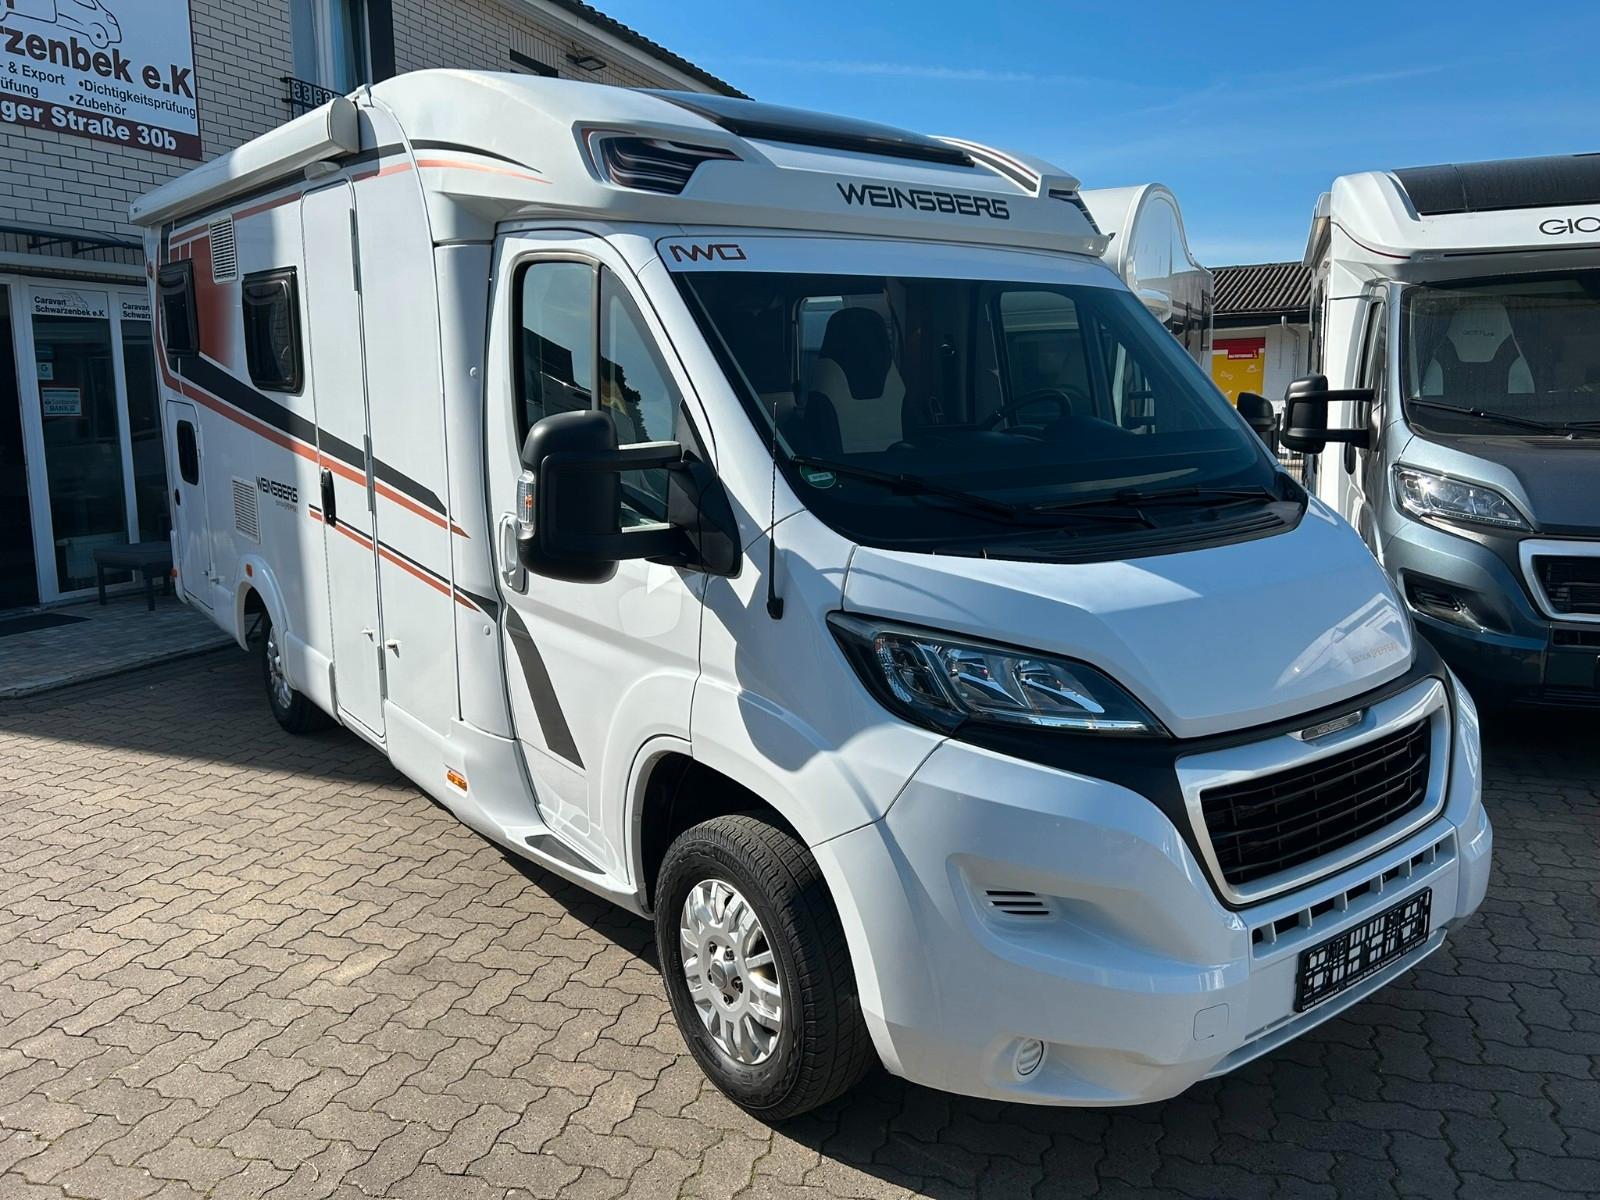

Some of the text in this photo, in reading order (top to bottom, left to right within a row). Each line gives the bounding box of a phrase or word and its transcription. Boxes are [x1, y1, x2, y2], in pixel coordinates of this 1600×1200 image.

[8, 61, 66, 86] & Export
[142, 64, 194, 99] e.K
[75, 94, 126, 116] Zubehör
[84, 80, 196, 119] Dichtigkeitsprüfung
[51, 106, 130, 140] Straße
[137, 125, 177, 150] 30b
[836, 182, 1010, 220] WEINSBERG
[34, 296, 66, 305] Caravan
[35, 305, 90, 316] Schwarzenbek
[256, 477, 298, 503] WEINSBERG
